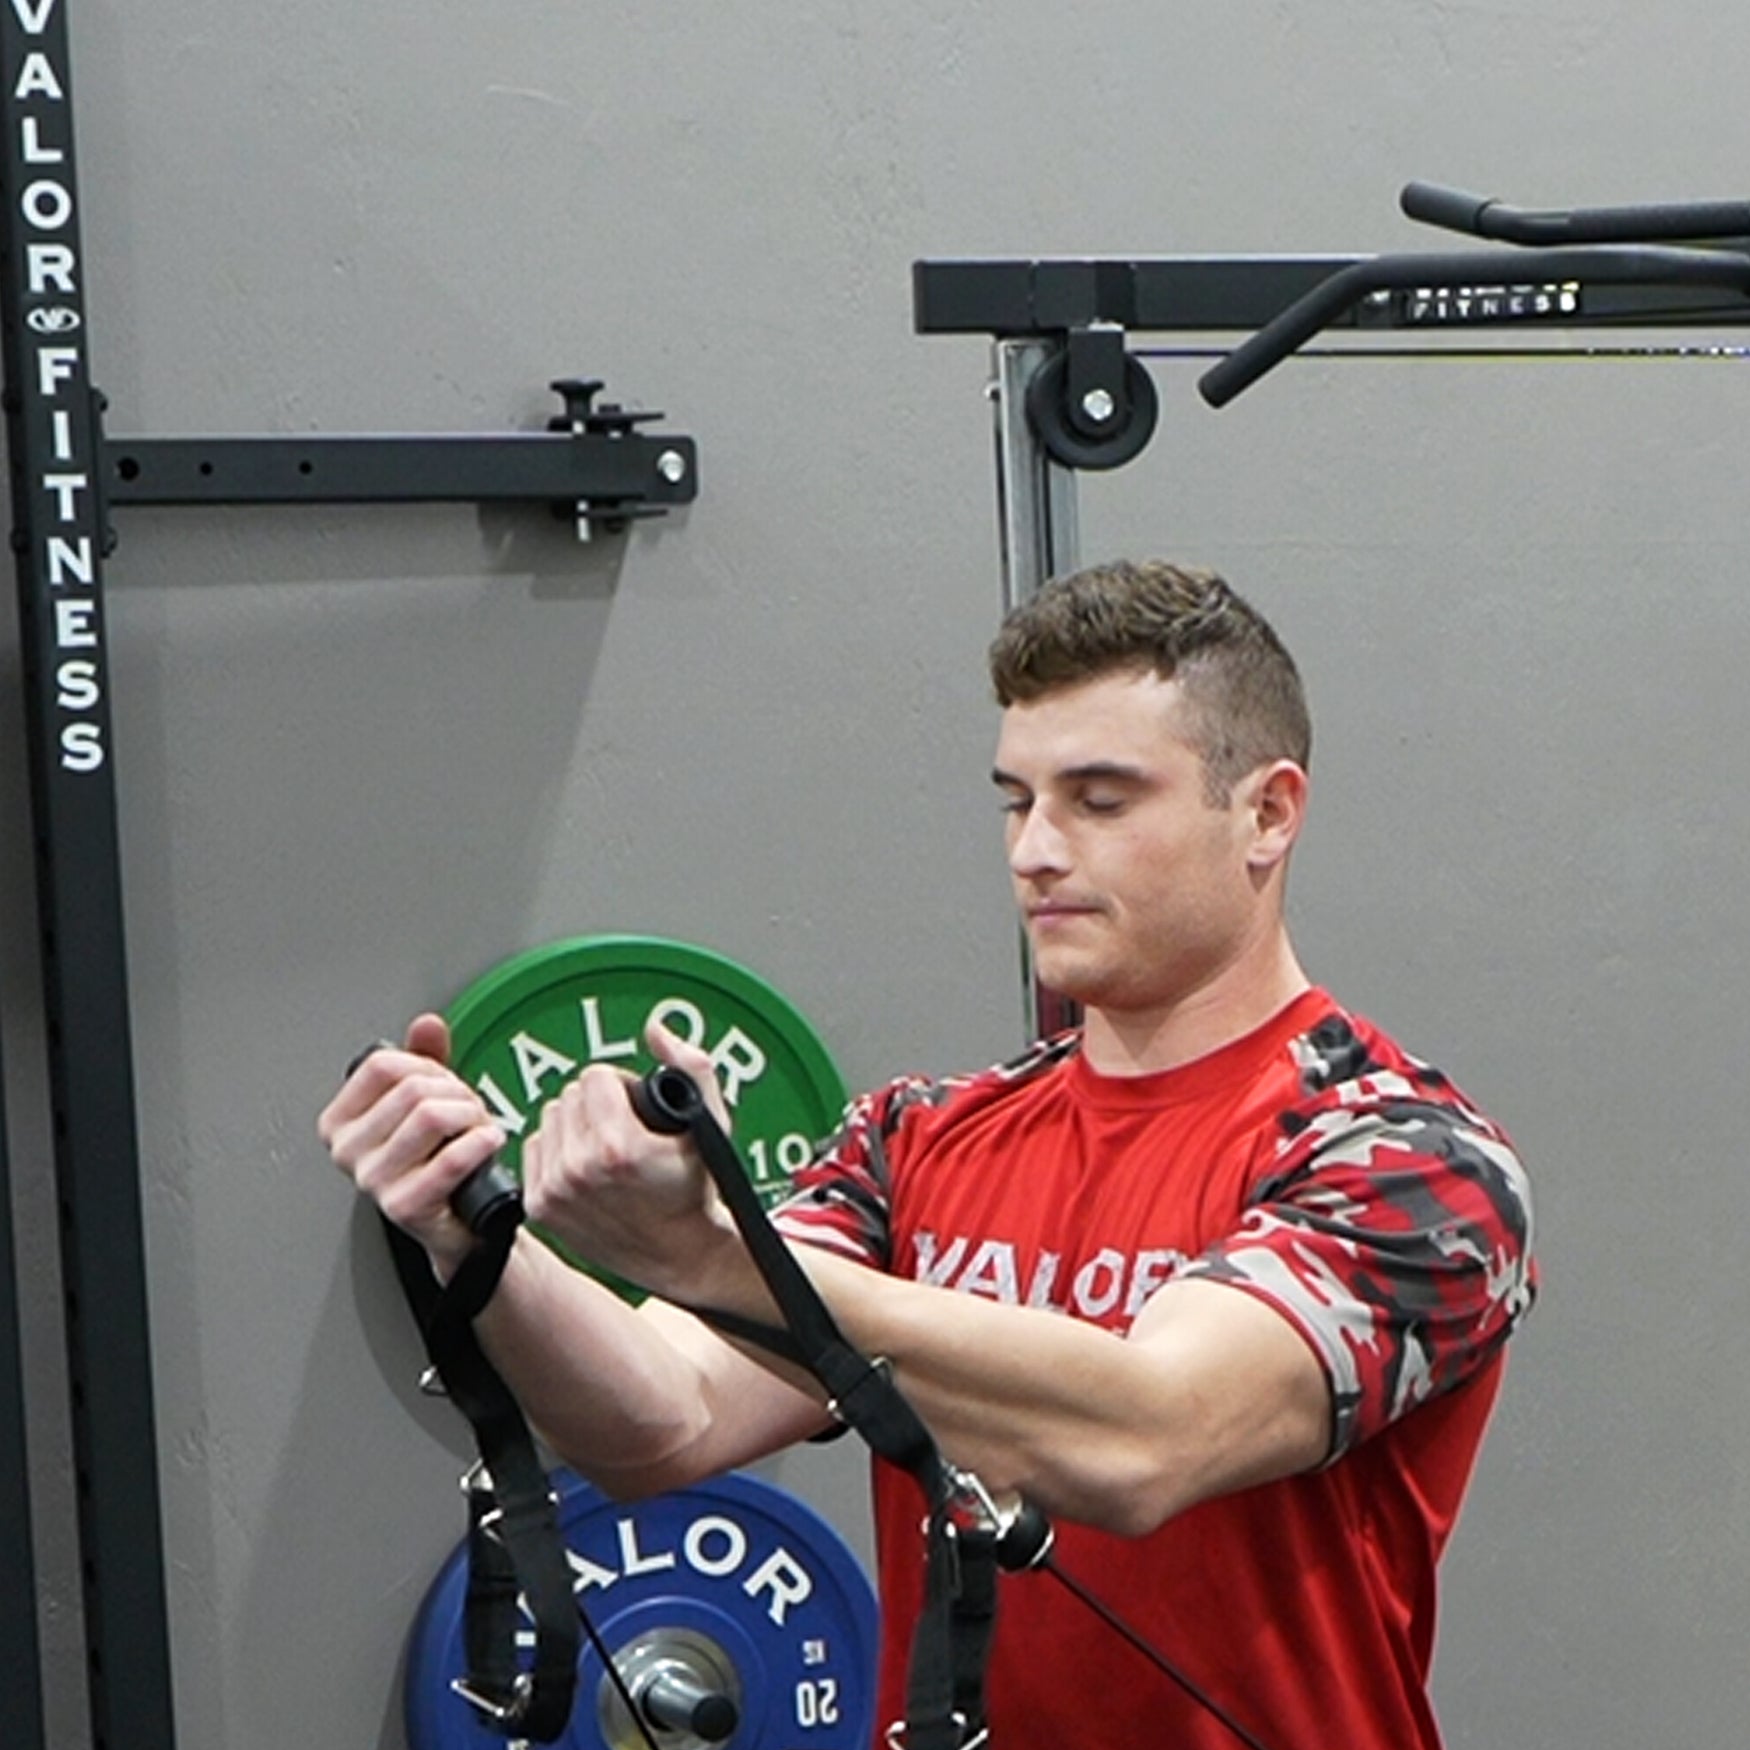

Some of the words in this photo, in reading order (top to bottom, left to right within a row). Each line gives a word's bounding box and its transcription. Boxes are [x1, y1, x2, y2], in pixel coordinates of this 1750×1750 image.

[12, 0, 76, 292] VALOR
[37, 347, 103, 772] FITNESS
[748, 1133, 812, 1179] 10
[796, 1679, 838, 1727] 20
